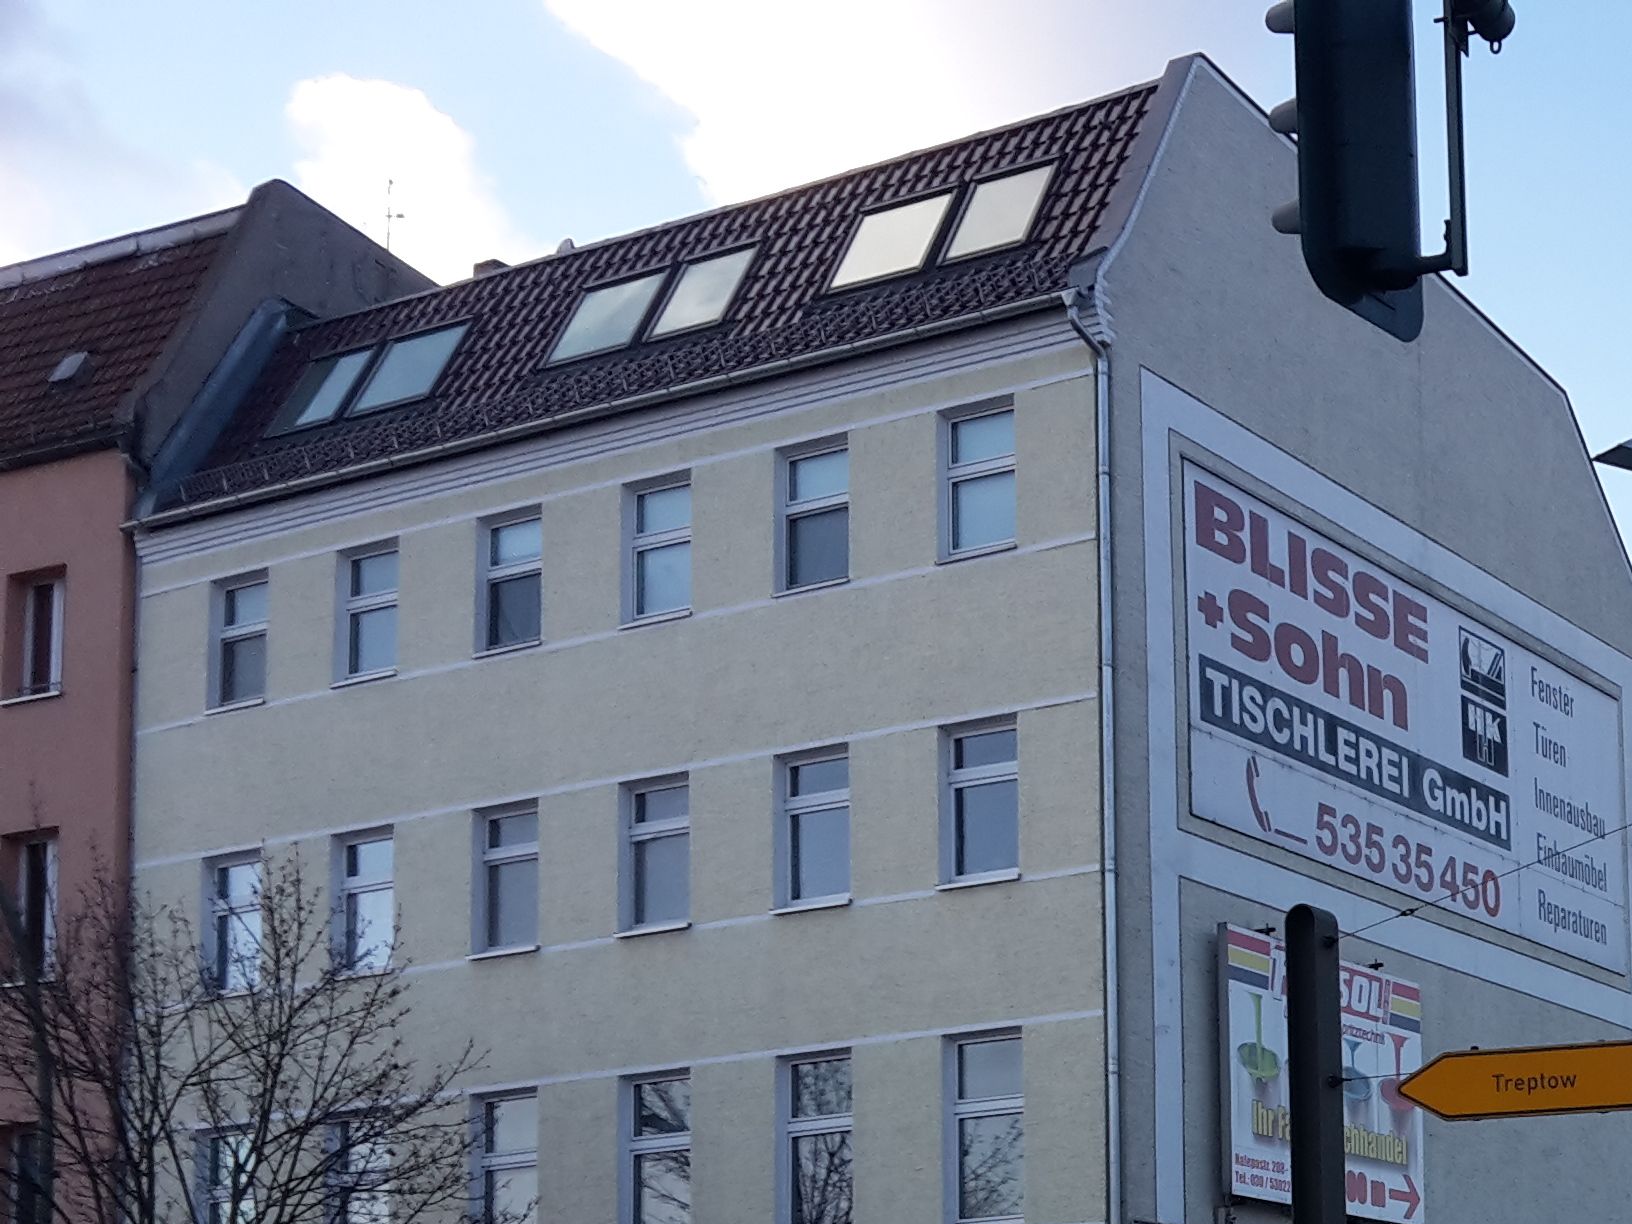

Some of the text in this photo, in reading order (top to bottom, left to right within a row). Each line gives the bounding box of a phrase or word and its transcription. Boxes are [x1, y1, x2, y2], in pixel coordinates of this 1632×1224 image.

[1193, 480, 1429, 664] BLISSE
[1530, 666, 1576, 718] Fenster
[1206, 672, 1508, 841] TISCHLEREI GmbH
[1533, 722, 1568, 768] Türen
[1534, 777, 1607, 840] Innenausbau
[1536, 832, 1609, 893] Einbaumöbel
[1537, 889, 1608, 946] Reparaturen
[1491, 1072, 1578, 1096] Treptow
